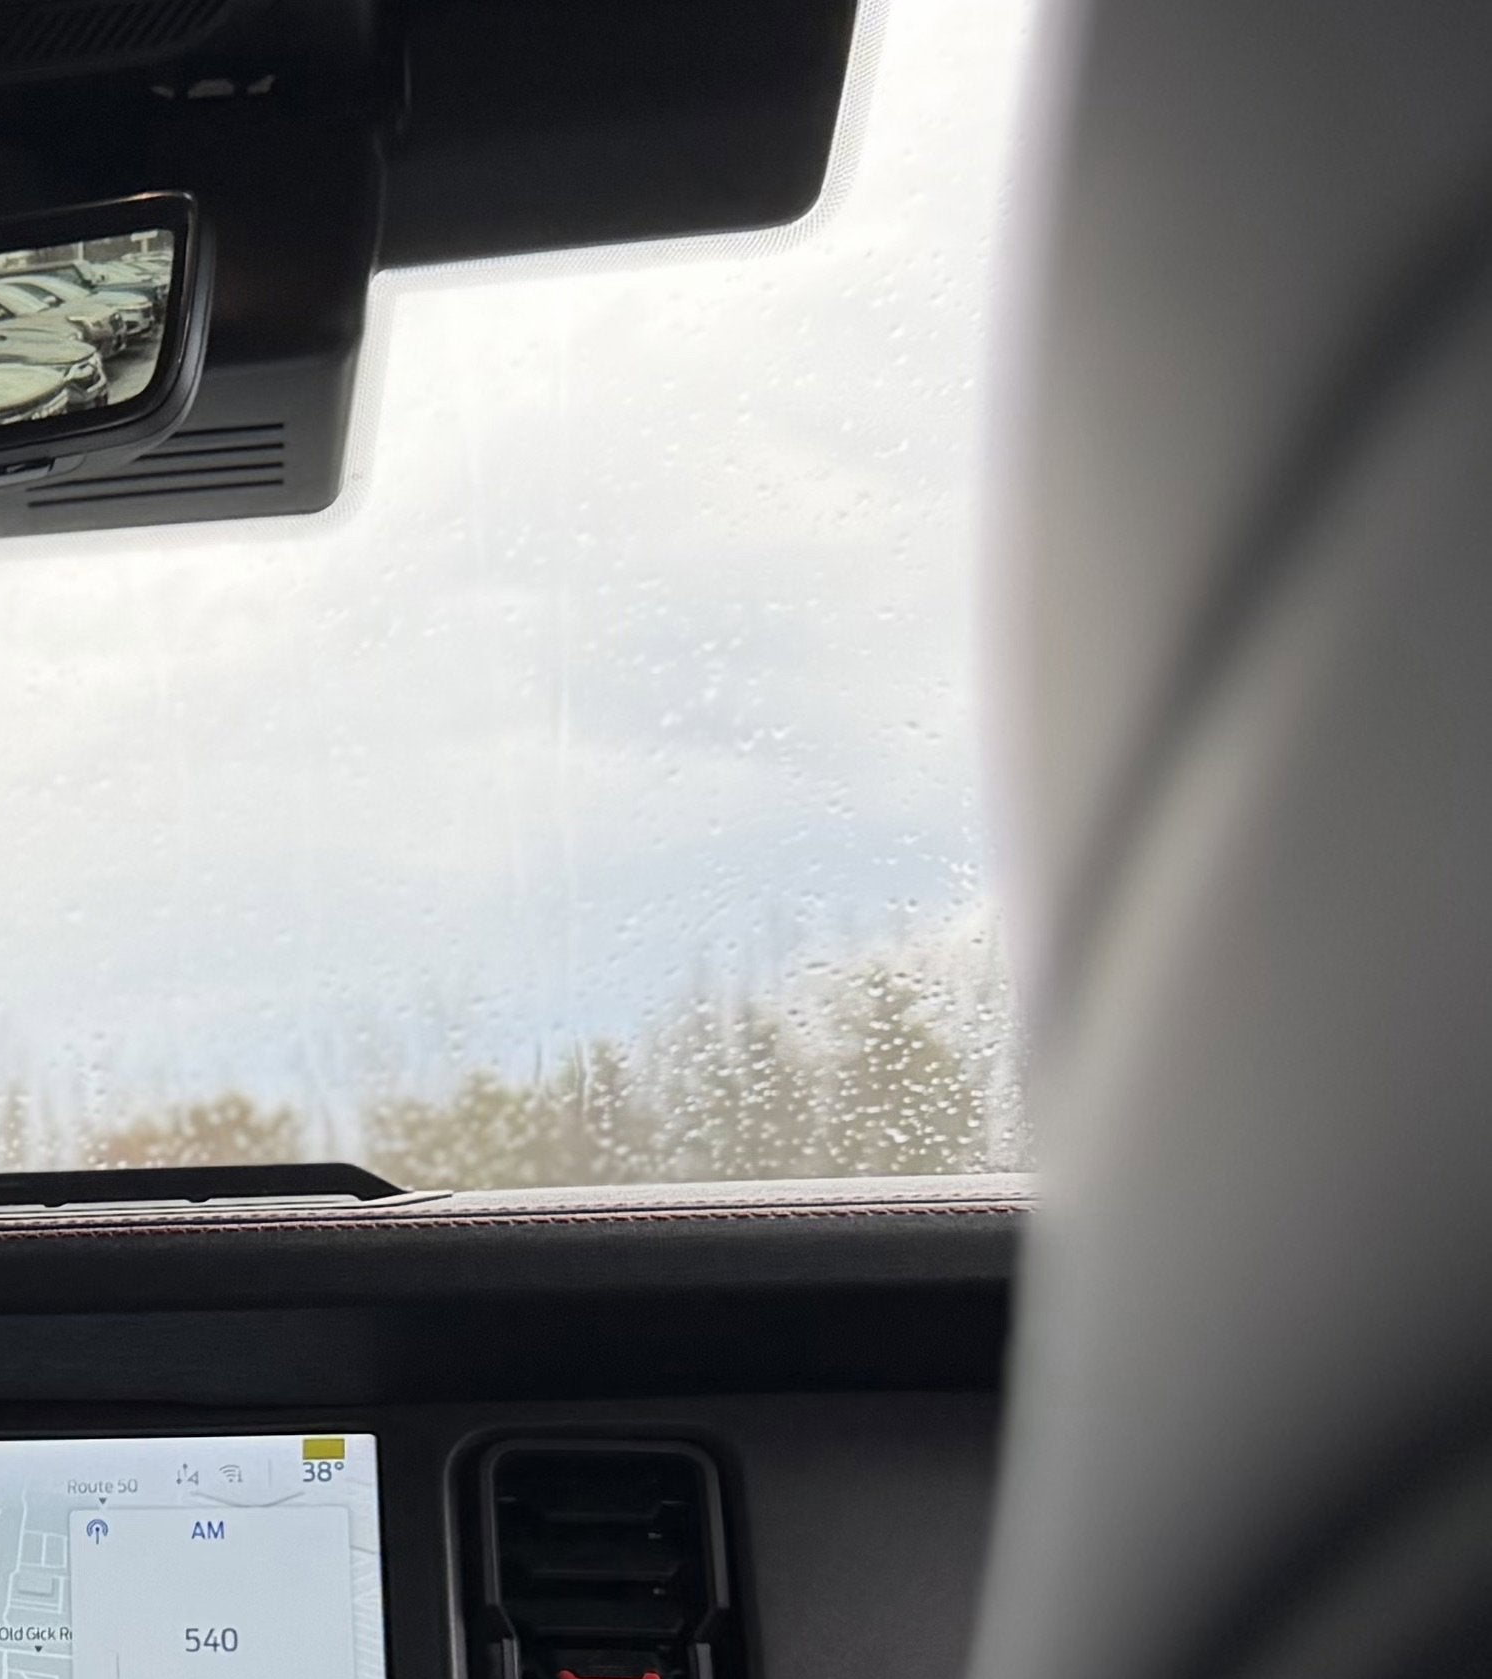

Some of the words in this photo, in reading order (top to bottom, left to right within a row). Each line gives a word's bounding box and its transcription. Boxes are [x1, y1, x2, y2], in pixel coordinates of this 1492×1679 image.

[302, 1461, 345, 1483] 38°
[67, 1479, 113, 1494] Route
[118, 1479, 139, 1494] 50
[191, 1522, 226, 1540] AM
[26, 1626, 56, 1641] Gick
[184, 1628, 240, 1653] 540
